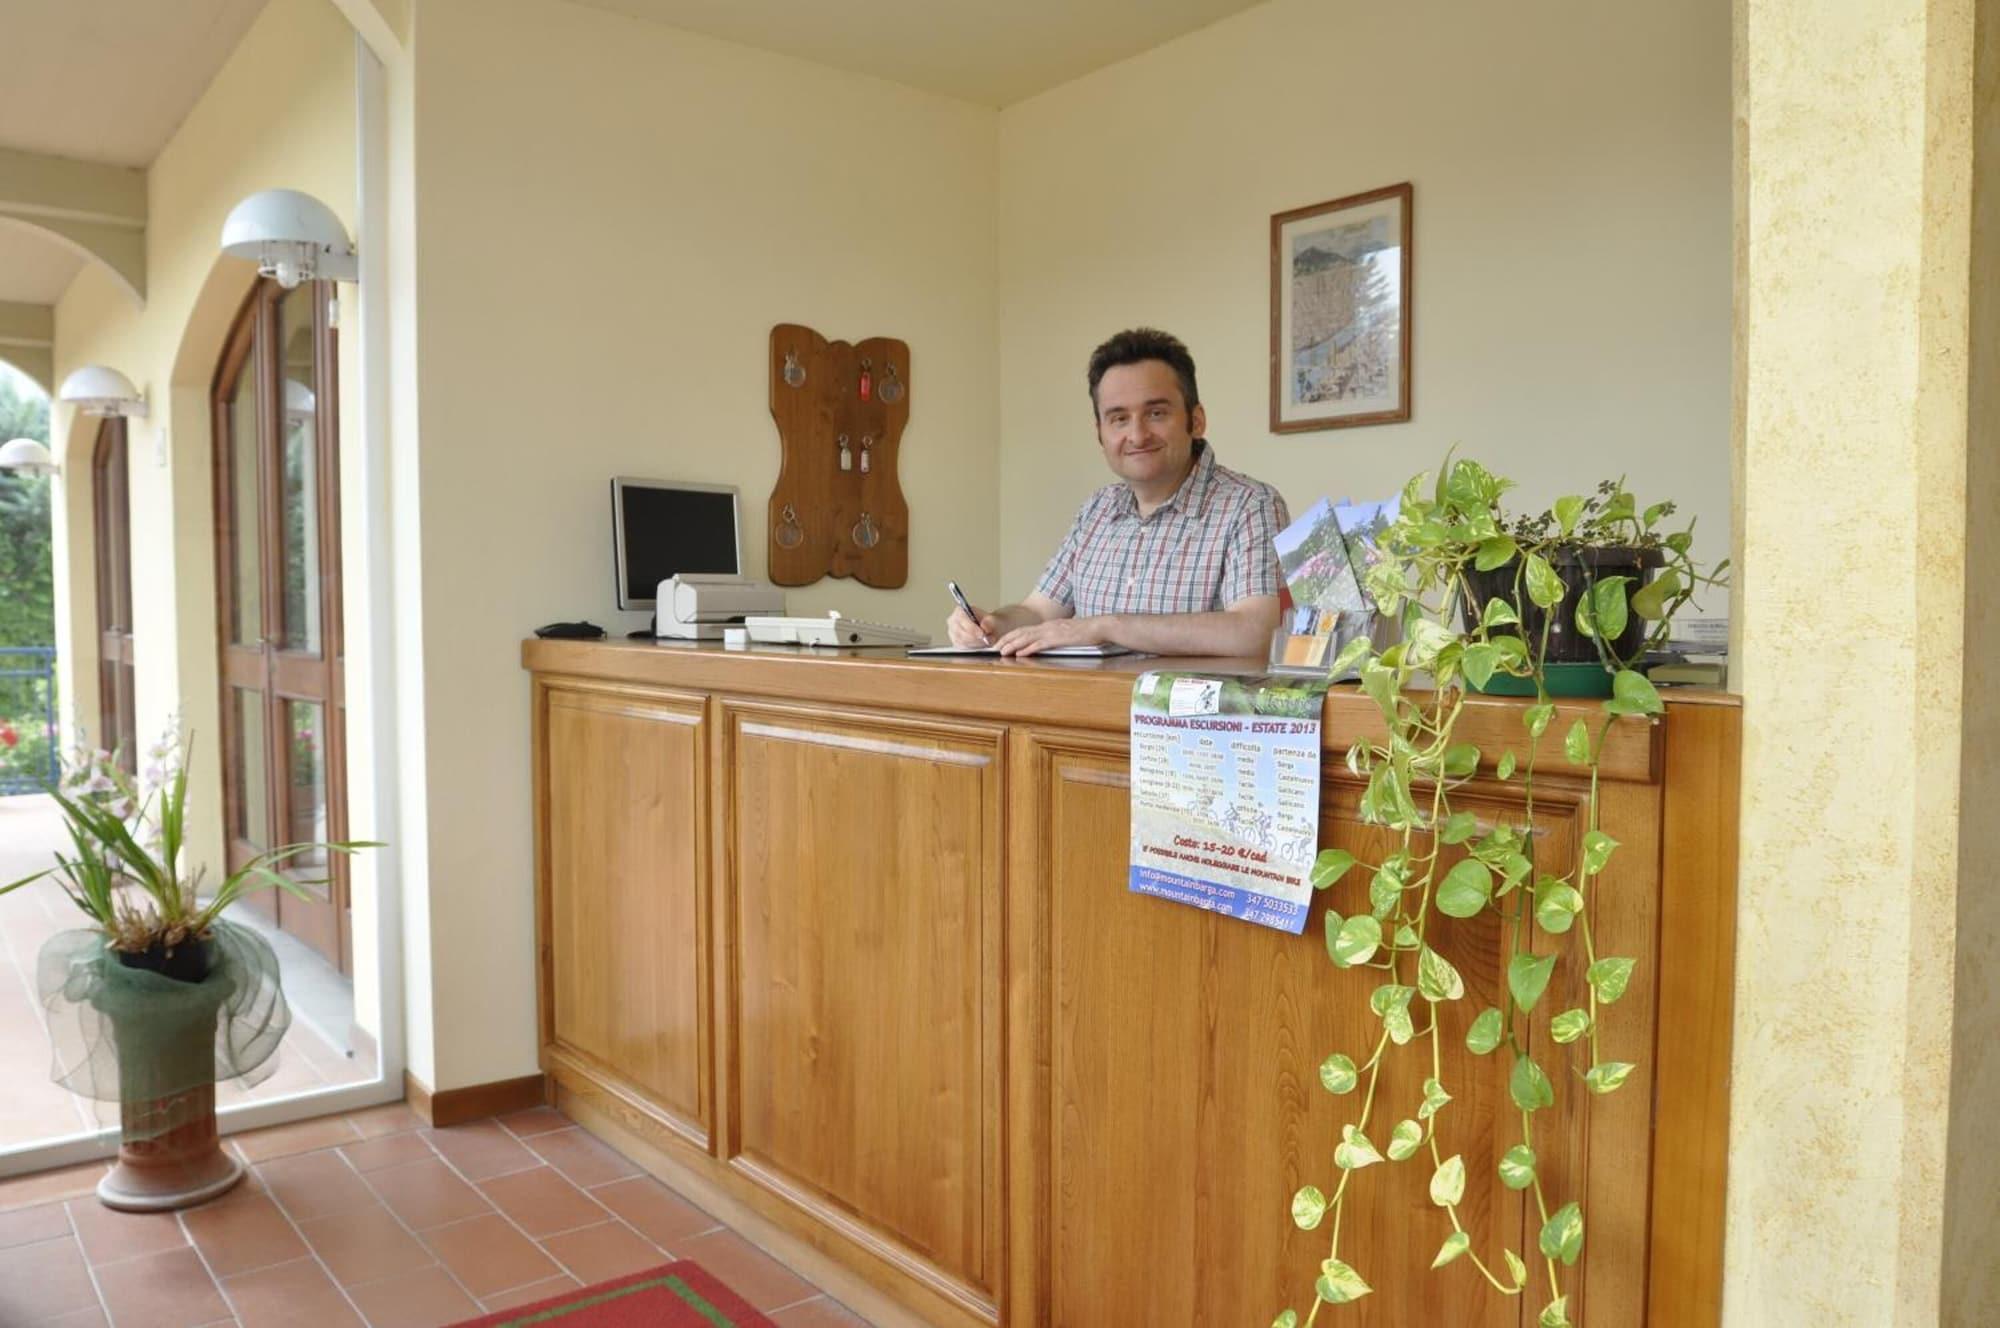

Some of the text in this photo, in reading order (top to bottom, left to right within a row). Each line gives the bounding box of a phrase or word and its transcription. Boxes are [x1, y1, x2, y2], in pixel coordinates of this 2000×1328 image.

[1134, 715, 1188, 729] PROGRAMMA
[1190, 719, 1242, 732] ESCURSIONI
[1251, 722, 1287, 734] ESTATE
[1290, 722, 1316, 734] 2013
[1203, 841, 1235, 856] 15-20
